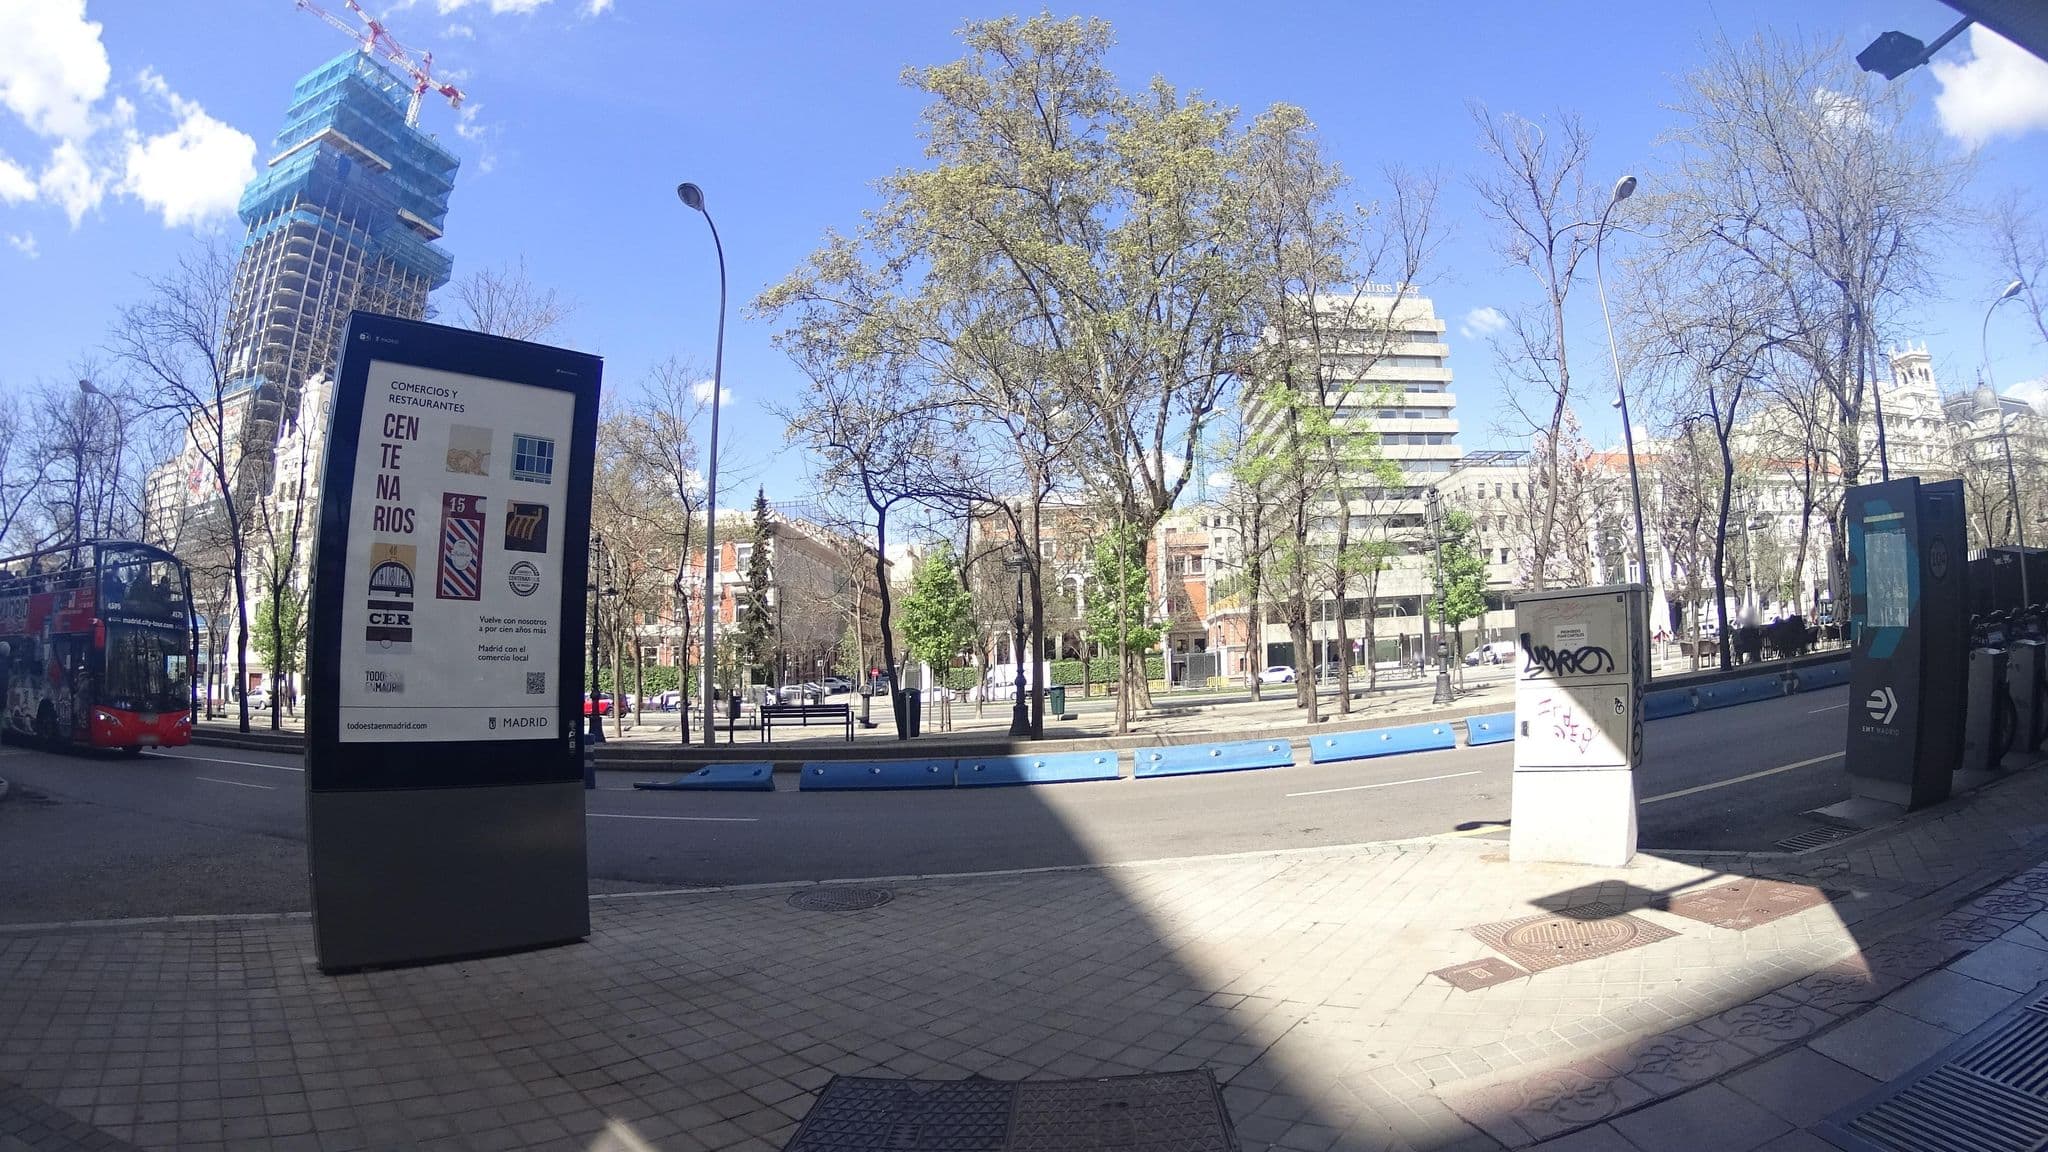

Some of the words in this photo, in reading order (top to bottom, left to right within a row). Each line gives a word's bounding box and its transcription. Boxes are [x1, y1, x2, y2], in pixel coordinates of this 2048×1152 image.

[390, 381, 450, 398] COMERCIOS
[451, 390, 459, 399] Y
[388, 394, 466, 413] RESTAURANTES
[383, 413, 420, 441] CEN
[380, 443, 403, 470] TE
[376, 474, 401, 501] NA
[449, 497, 466, 513] 15
[373, 505, 416, 534] RIOS
[369, 613, 411, 626] CER
[480, 615, 502, 624] Vuelve
[517, 618, 547, 626] nosotros
[484, 626, 497, 634] por
[499, 625, 513, 633] cien
[478, 644, 503, 653] Madrid
[519, 645, 526, 653] el
[477, 653, 511, 661] comercio
[346, 721, 428, 730] todoestaenmadrid.com
[503, 717, 548, 728] MADRID
